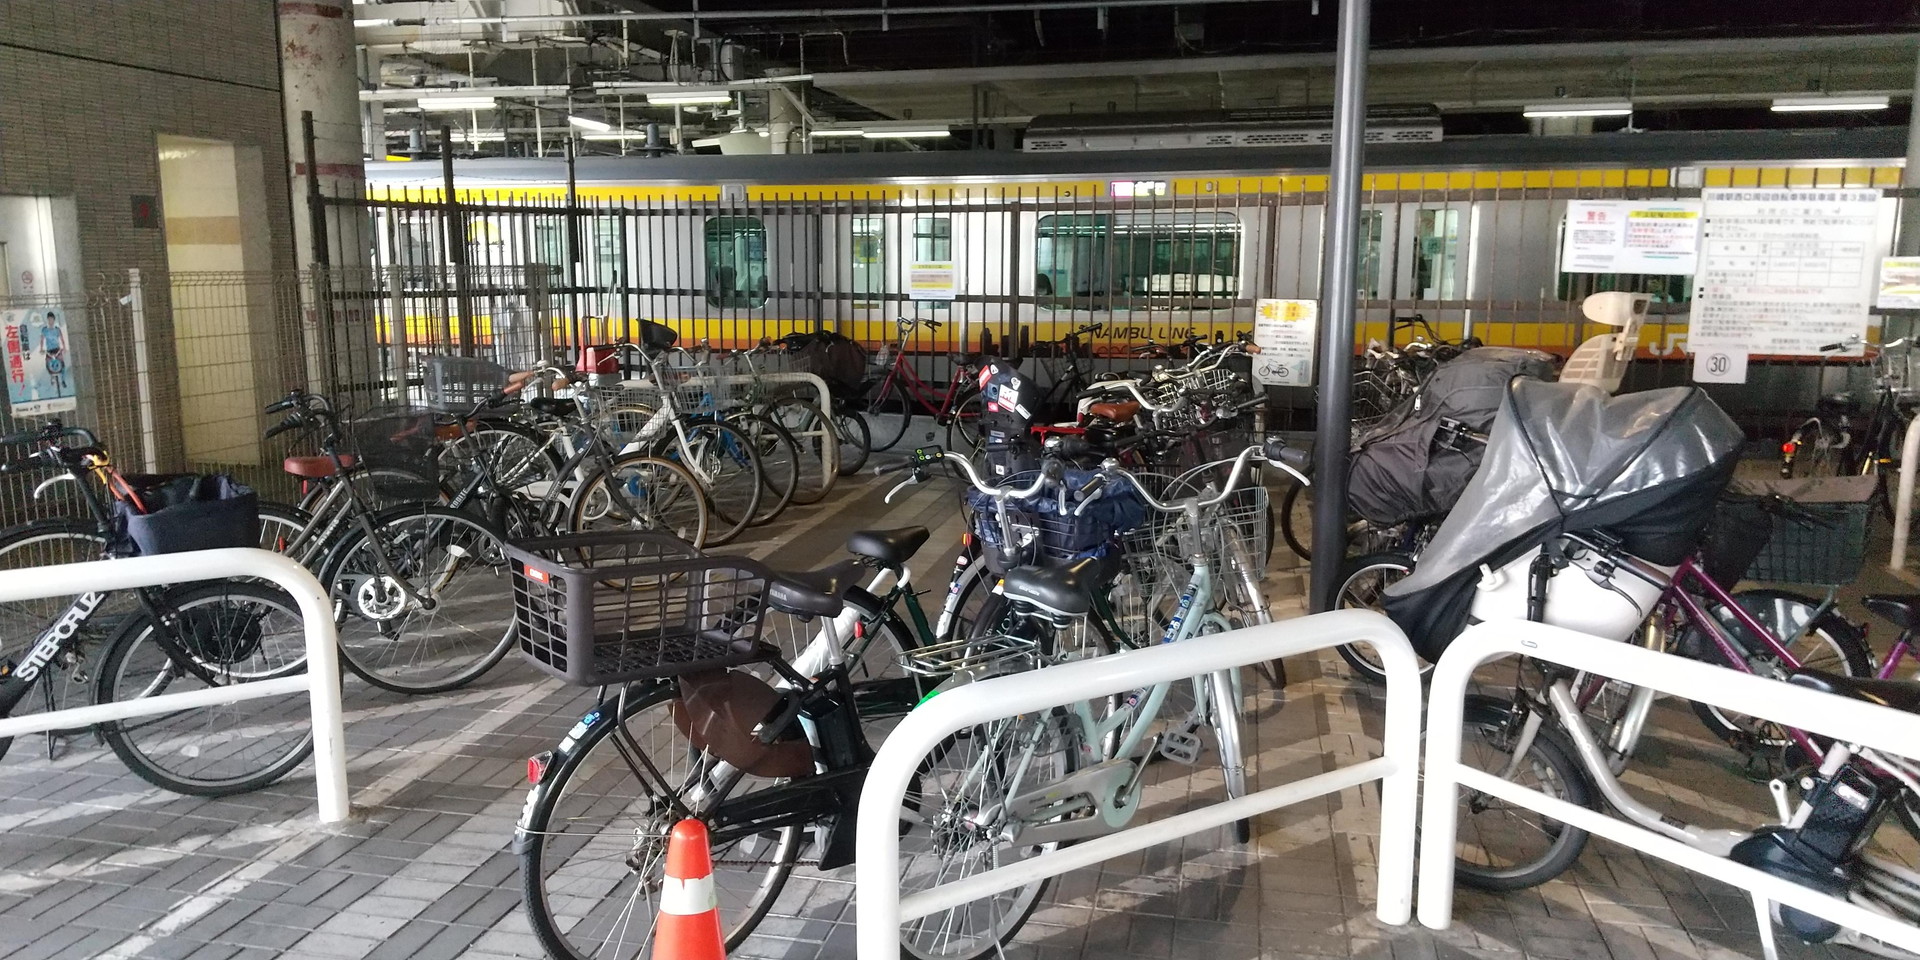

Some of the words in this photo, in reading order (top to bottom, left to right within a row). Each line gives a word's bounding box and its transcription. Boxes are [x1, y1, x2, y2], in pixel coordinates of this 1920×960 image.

[1587, 211, 1607, 221] 警告
[1091, 326, 1152, 339] NAMBU
[1158, 327, 1196, 339] LNE
[1709, 356, 1728, 373] 30
[16, 591, 105, 682] STEPCRUZ
